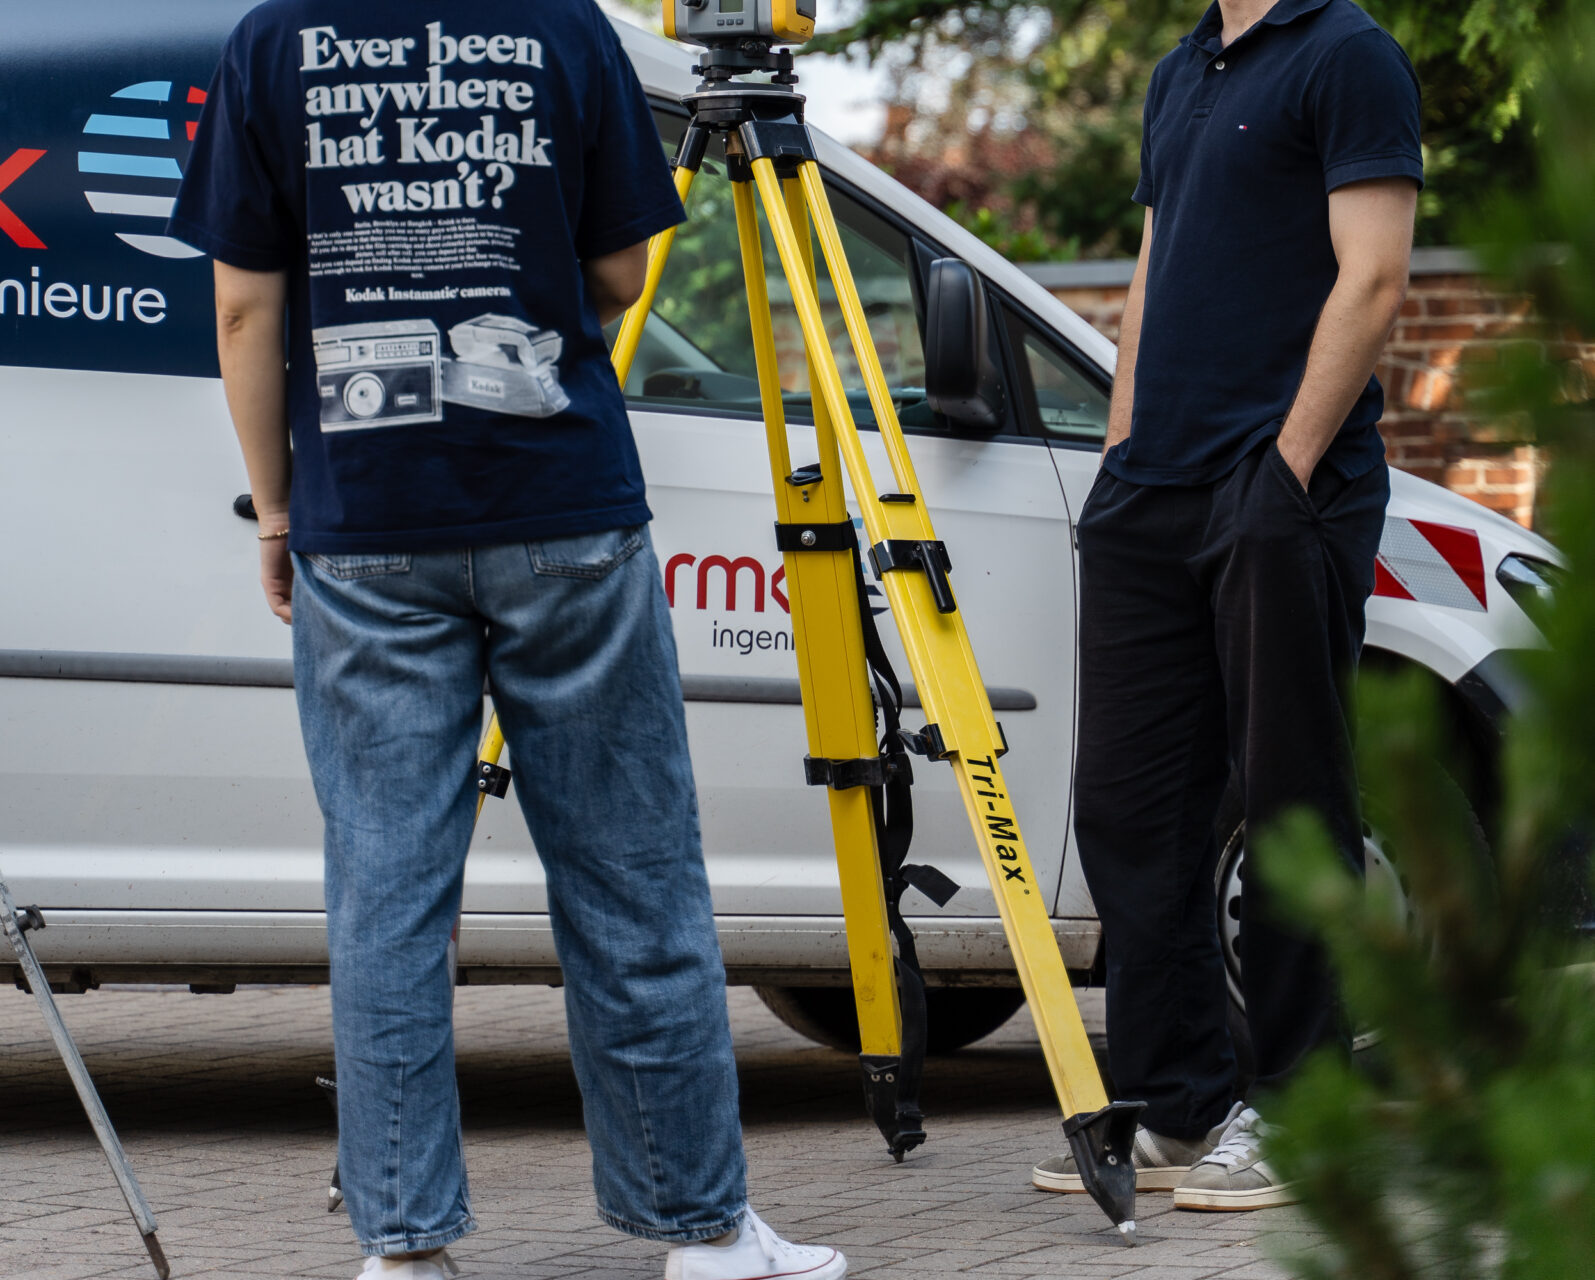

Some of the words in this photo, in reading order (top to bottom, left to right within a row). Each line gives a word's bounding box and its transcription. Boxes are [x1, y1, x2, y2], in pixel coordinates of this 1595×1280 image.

[299, 25, 415, 70] Ever
[426, 21, 544, 69] been
[305, 65, 534, 128] anywhere
[305, 122, 384, 168] hat
[396, 114, 552, 166] Kodak
[341, 162, 515, 214] wasn't?
[344, 288, 386, 302] Kodak
[966, 755, 1026, 884] Tri-Max
